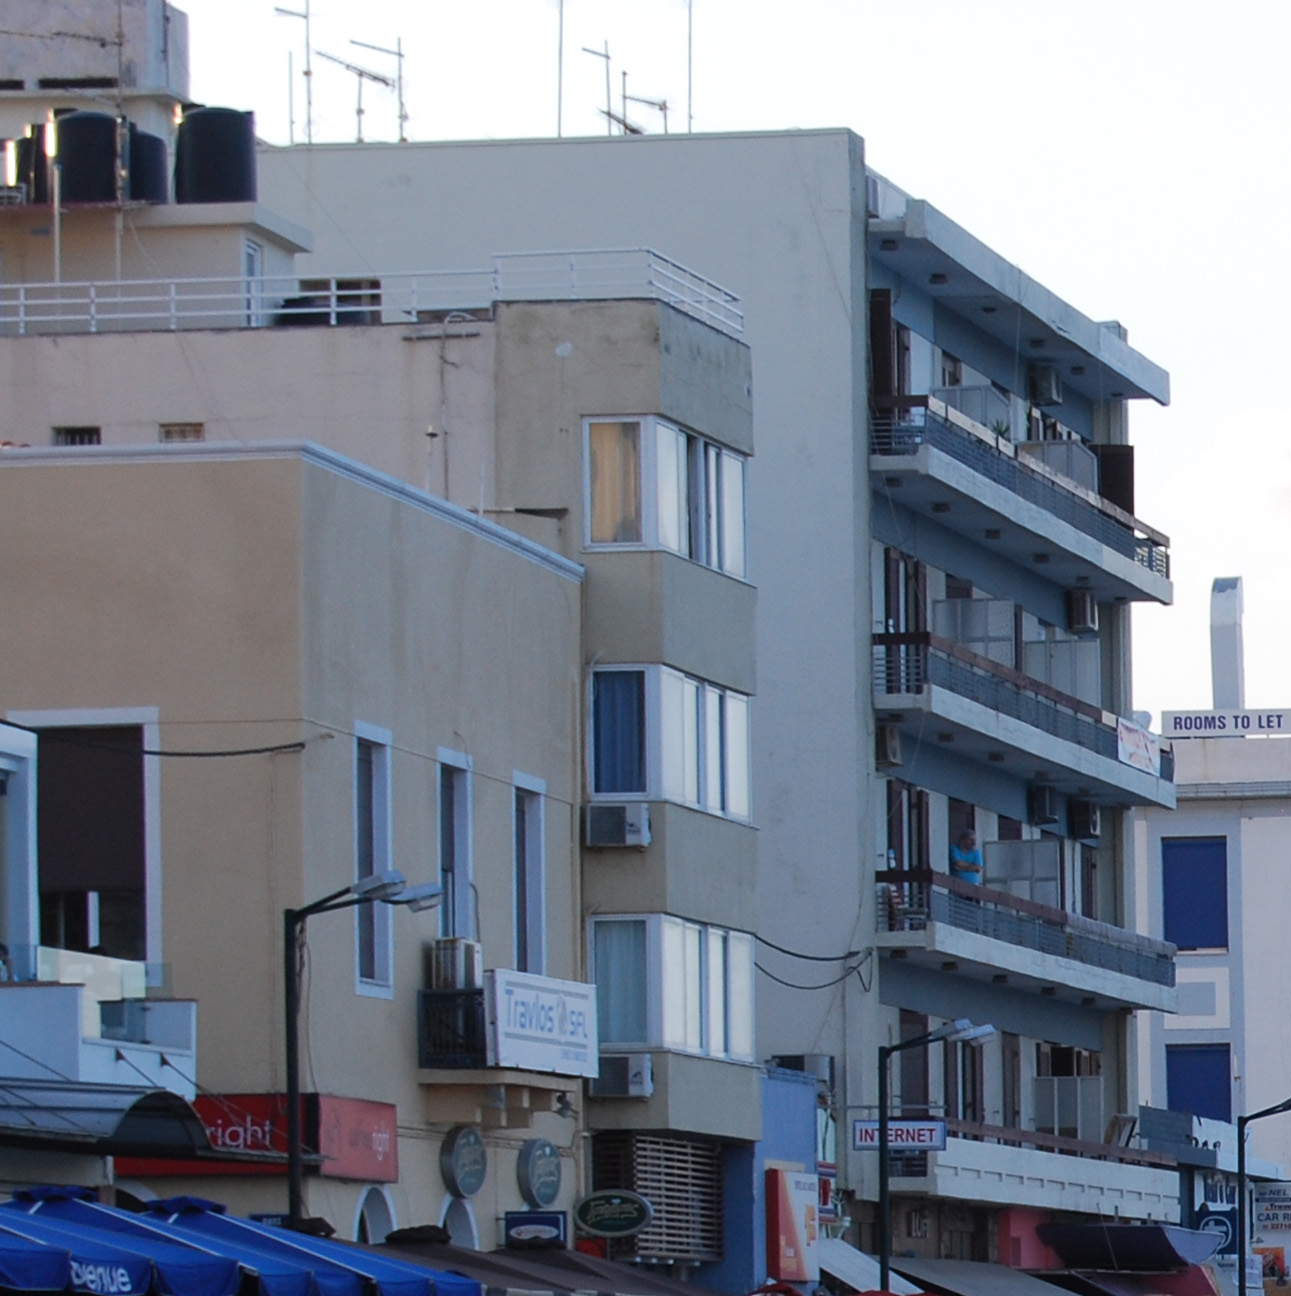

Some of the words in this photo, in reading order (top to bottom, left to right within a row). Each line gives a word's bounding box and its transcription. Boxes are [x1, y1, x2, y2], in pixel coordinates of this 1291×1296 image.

[1173, 715, 1227, 730] ROOMS
[1233, 715, 1250, 729] TO
[1258, 714, 1283, 729] LET
[505, 989, 554, 1033] Travlos
[1257, 1213, 1279, 1222] CAR
